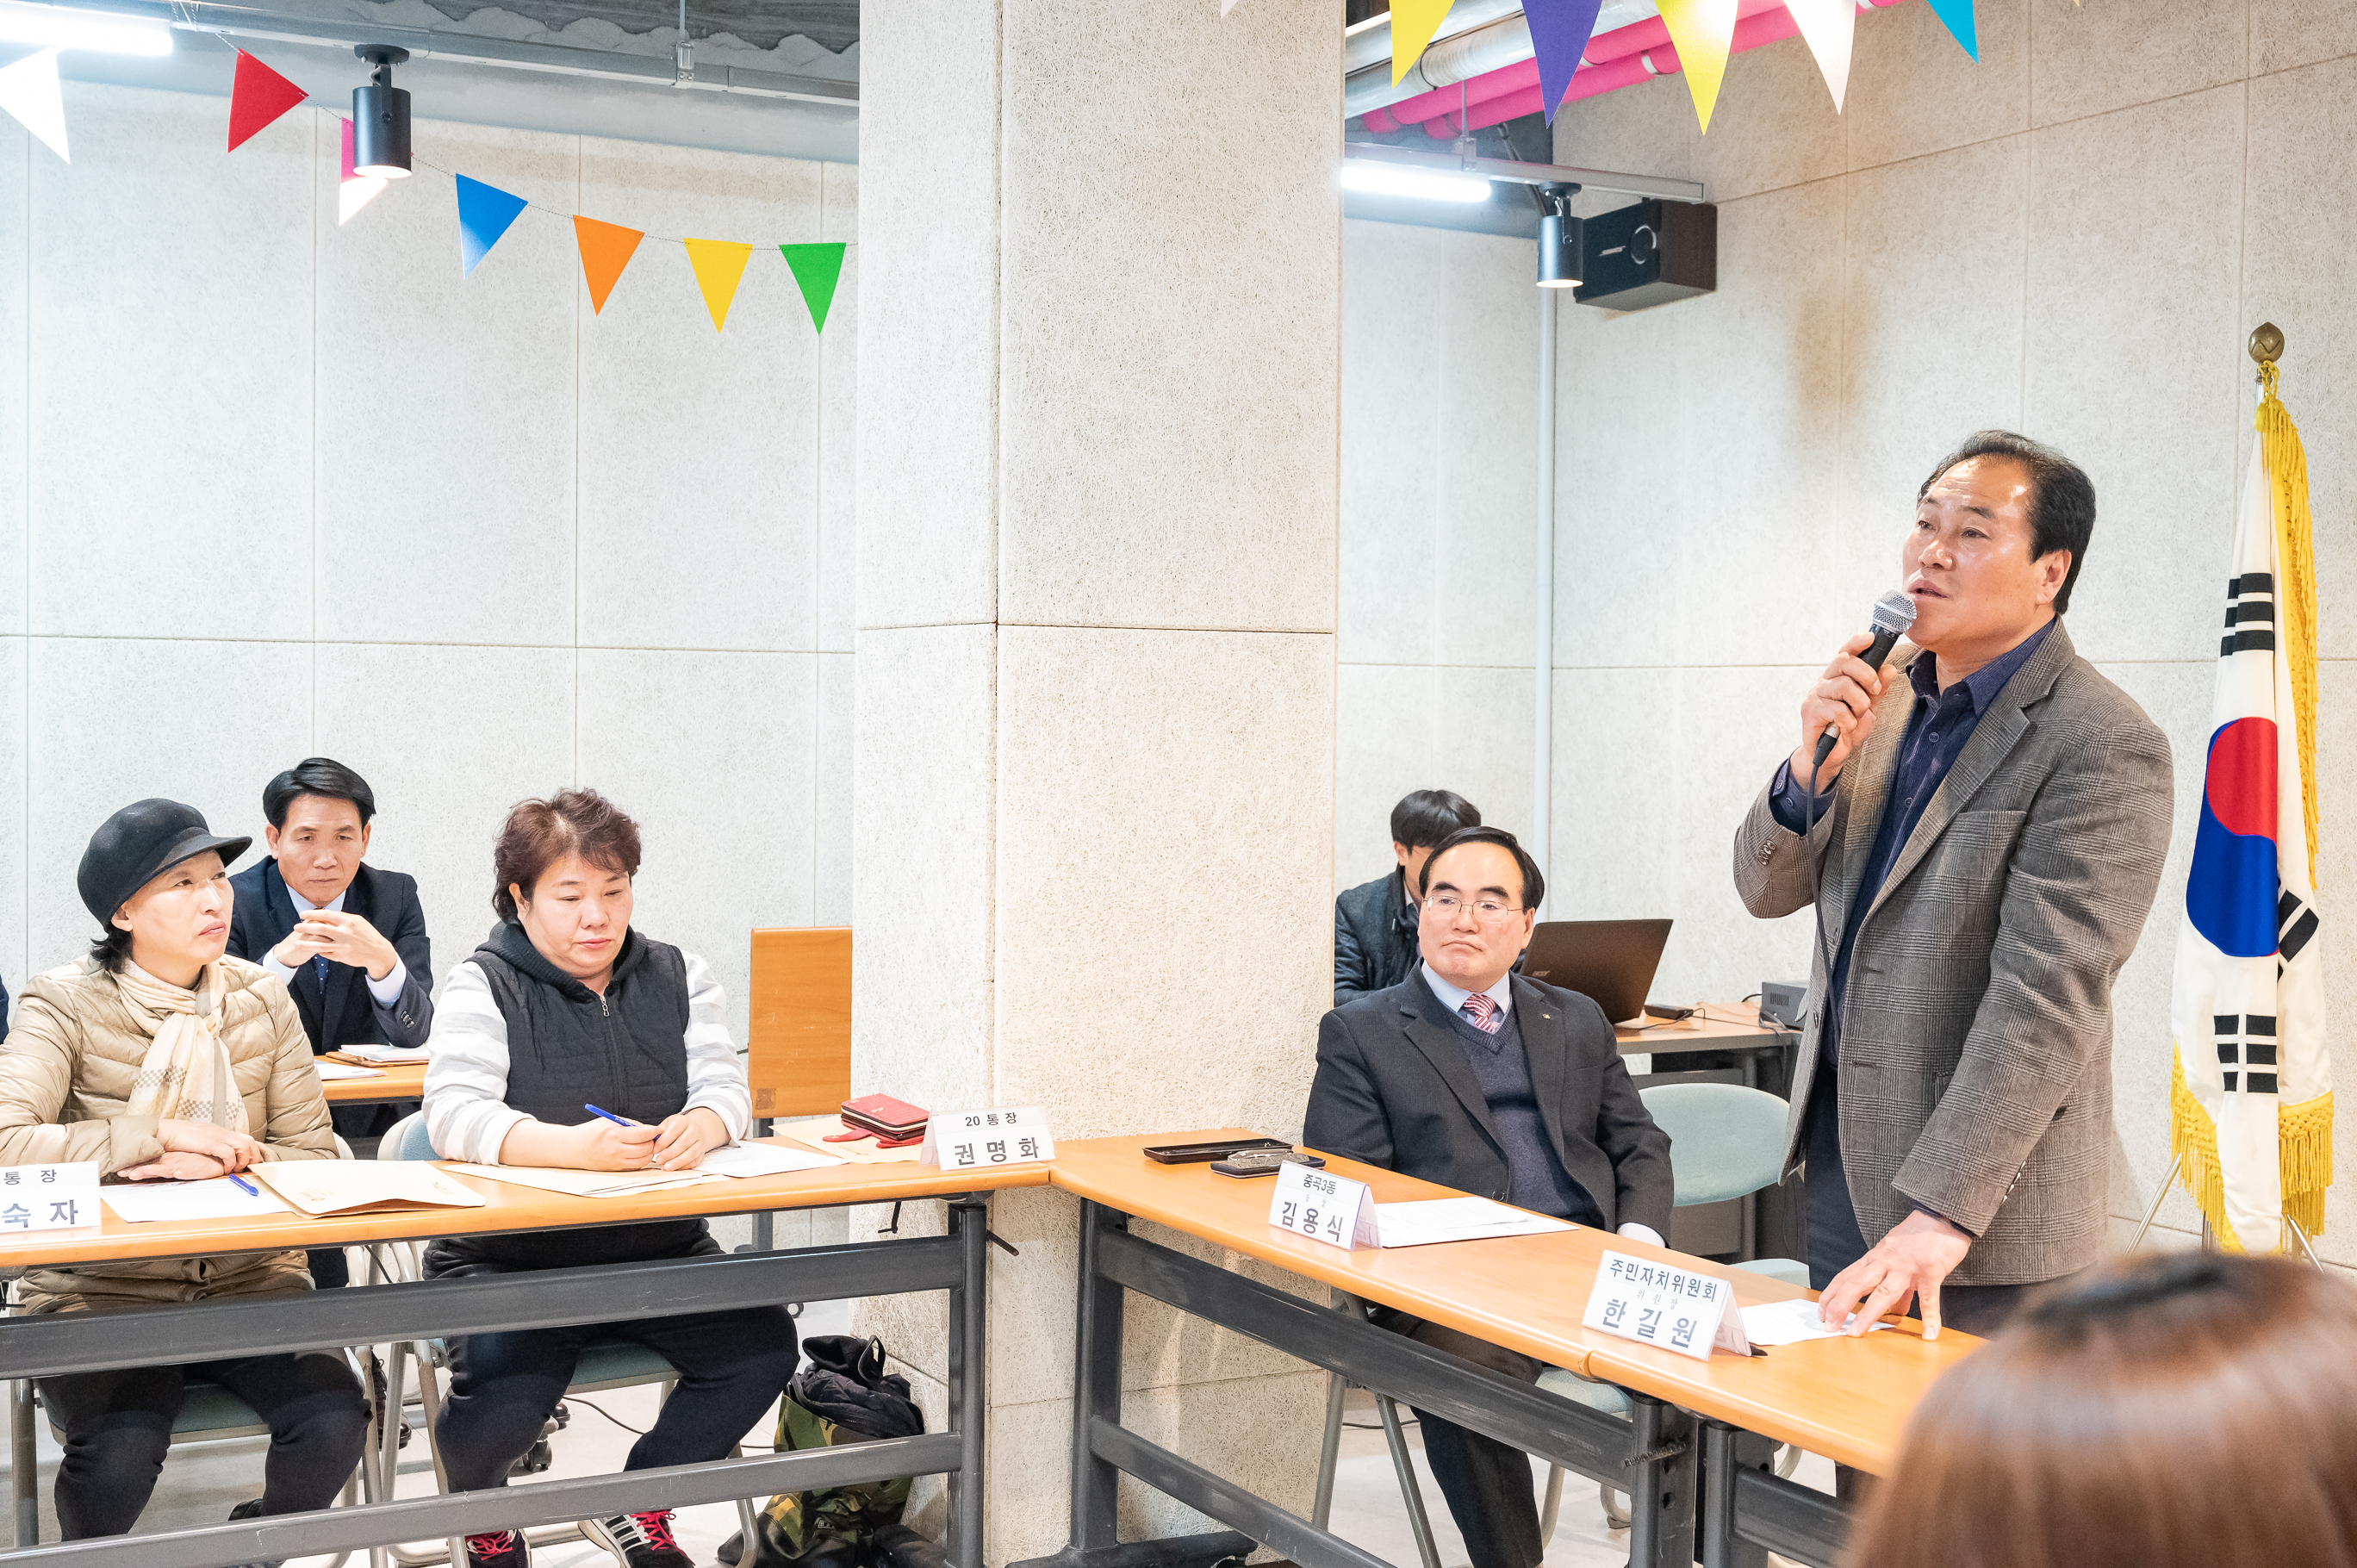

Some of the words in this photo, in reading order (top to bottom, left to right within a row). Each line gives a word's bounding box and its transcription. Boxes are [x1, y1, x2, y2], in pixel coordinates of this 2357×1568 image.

[965, 1116, 980, 1127] 20
[1303, 1173, 1336, 1195] 중곡3동
[1609, 1259, 1718, 1303] 주민자치위원회
